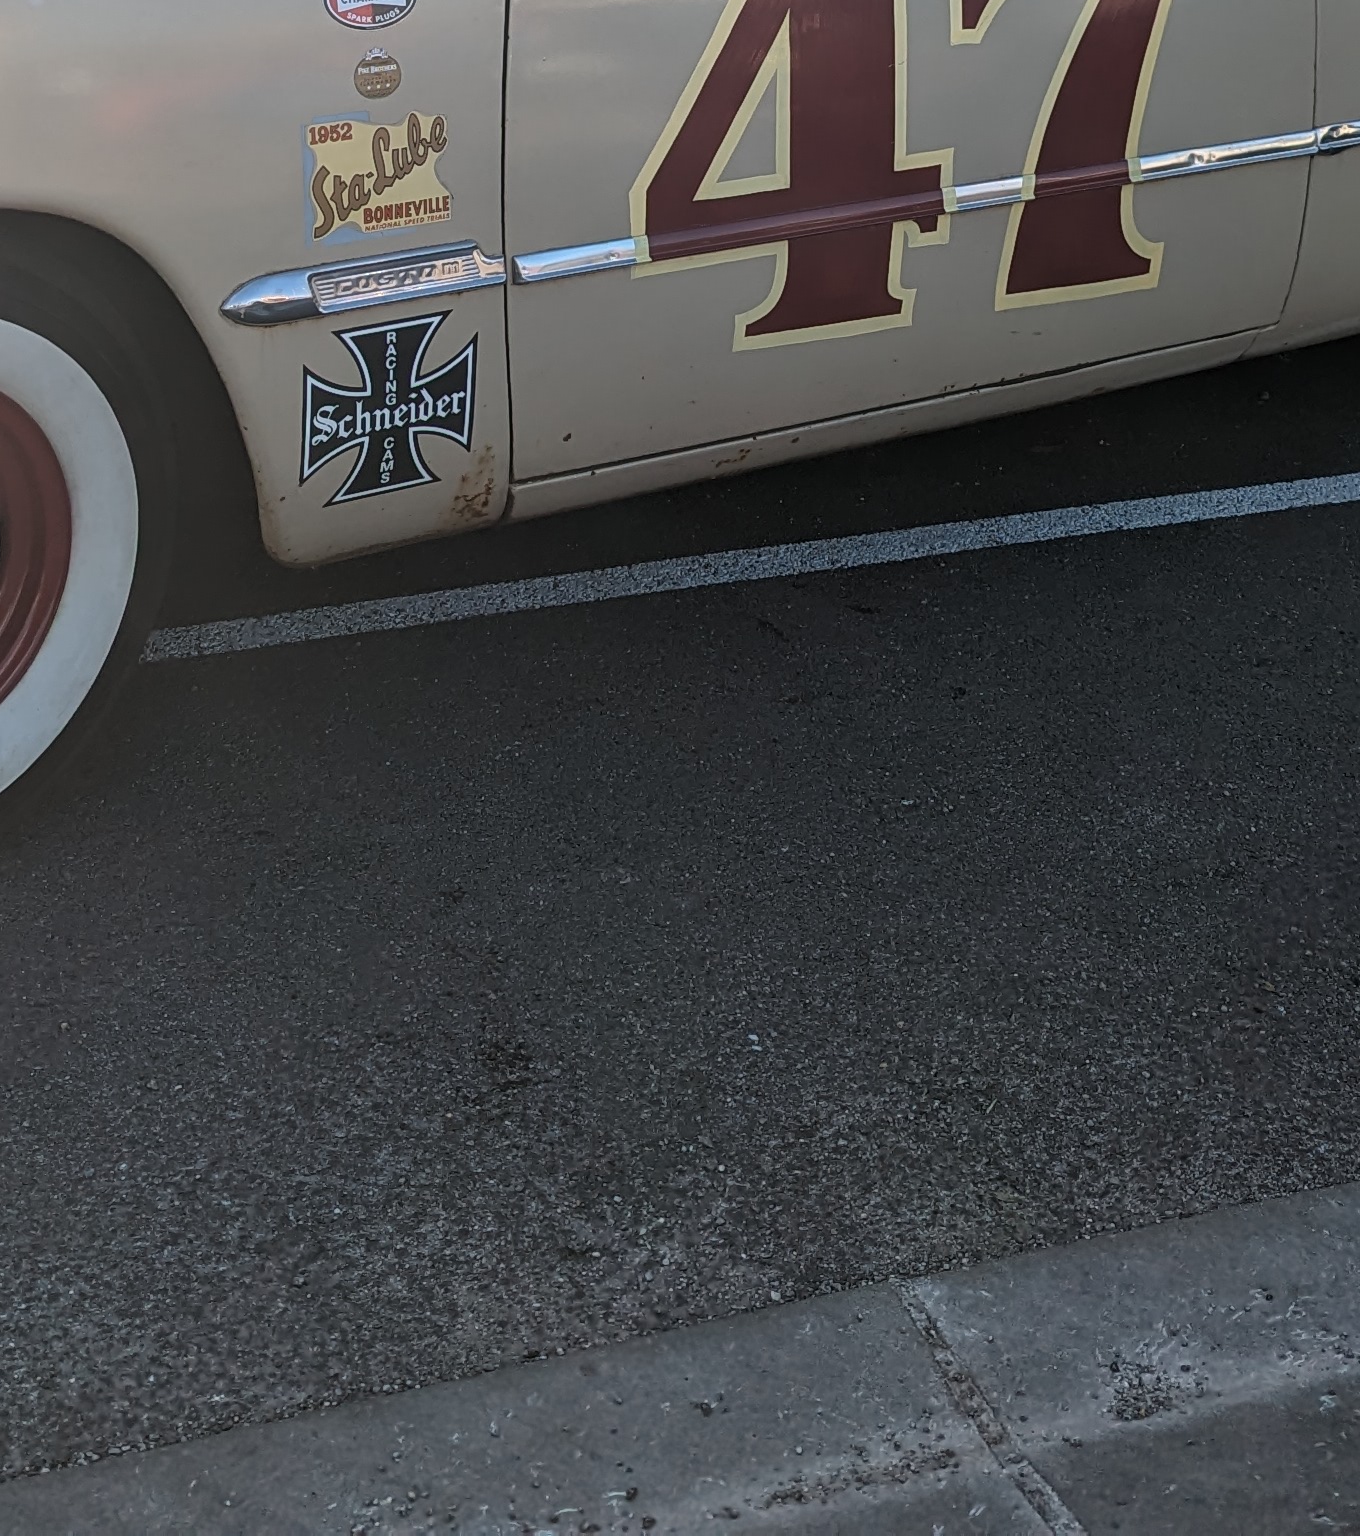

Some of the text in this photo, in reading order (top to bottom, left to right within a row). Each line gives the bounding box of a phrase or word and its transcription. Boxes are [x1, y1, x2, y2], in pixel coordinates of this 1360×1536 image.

[346, 7, 400, 23] SPARK PLUGS
[308, 122, 353, 146] 1952
[312, 112, 448, 239] Sta-Lube
[363, 195, 450, 225] BONNEVILLE
[364, 221, 402, 232] NATIONAL
[403, 216, 425, 227] SPEED
[385, 331, 397, 406] RACING
[311, 387, 466, 446] Schneider
[380, 437, 395, 484] CAMS
